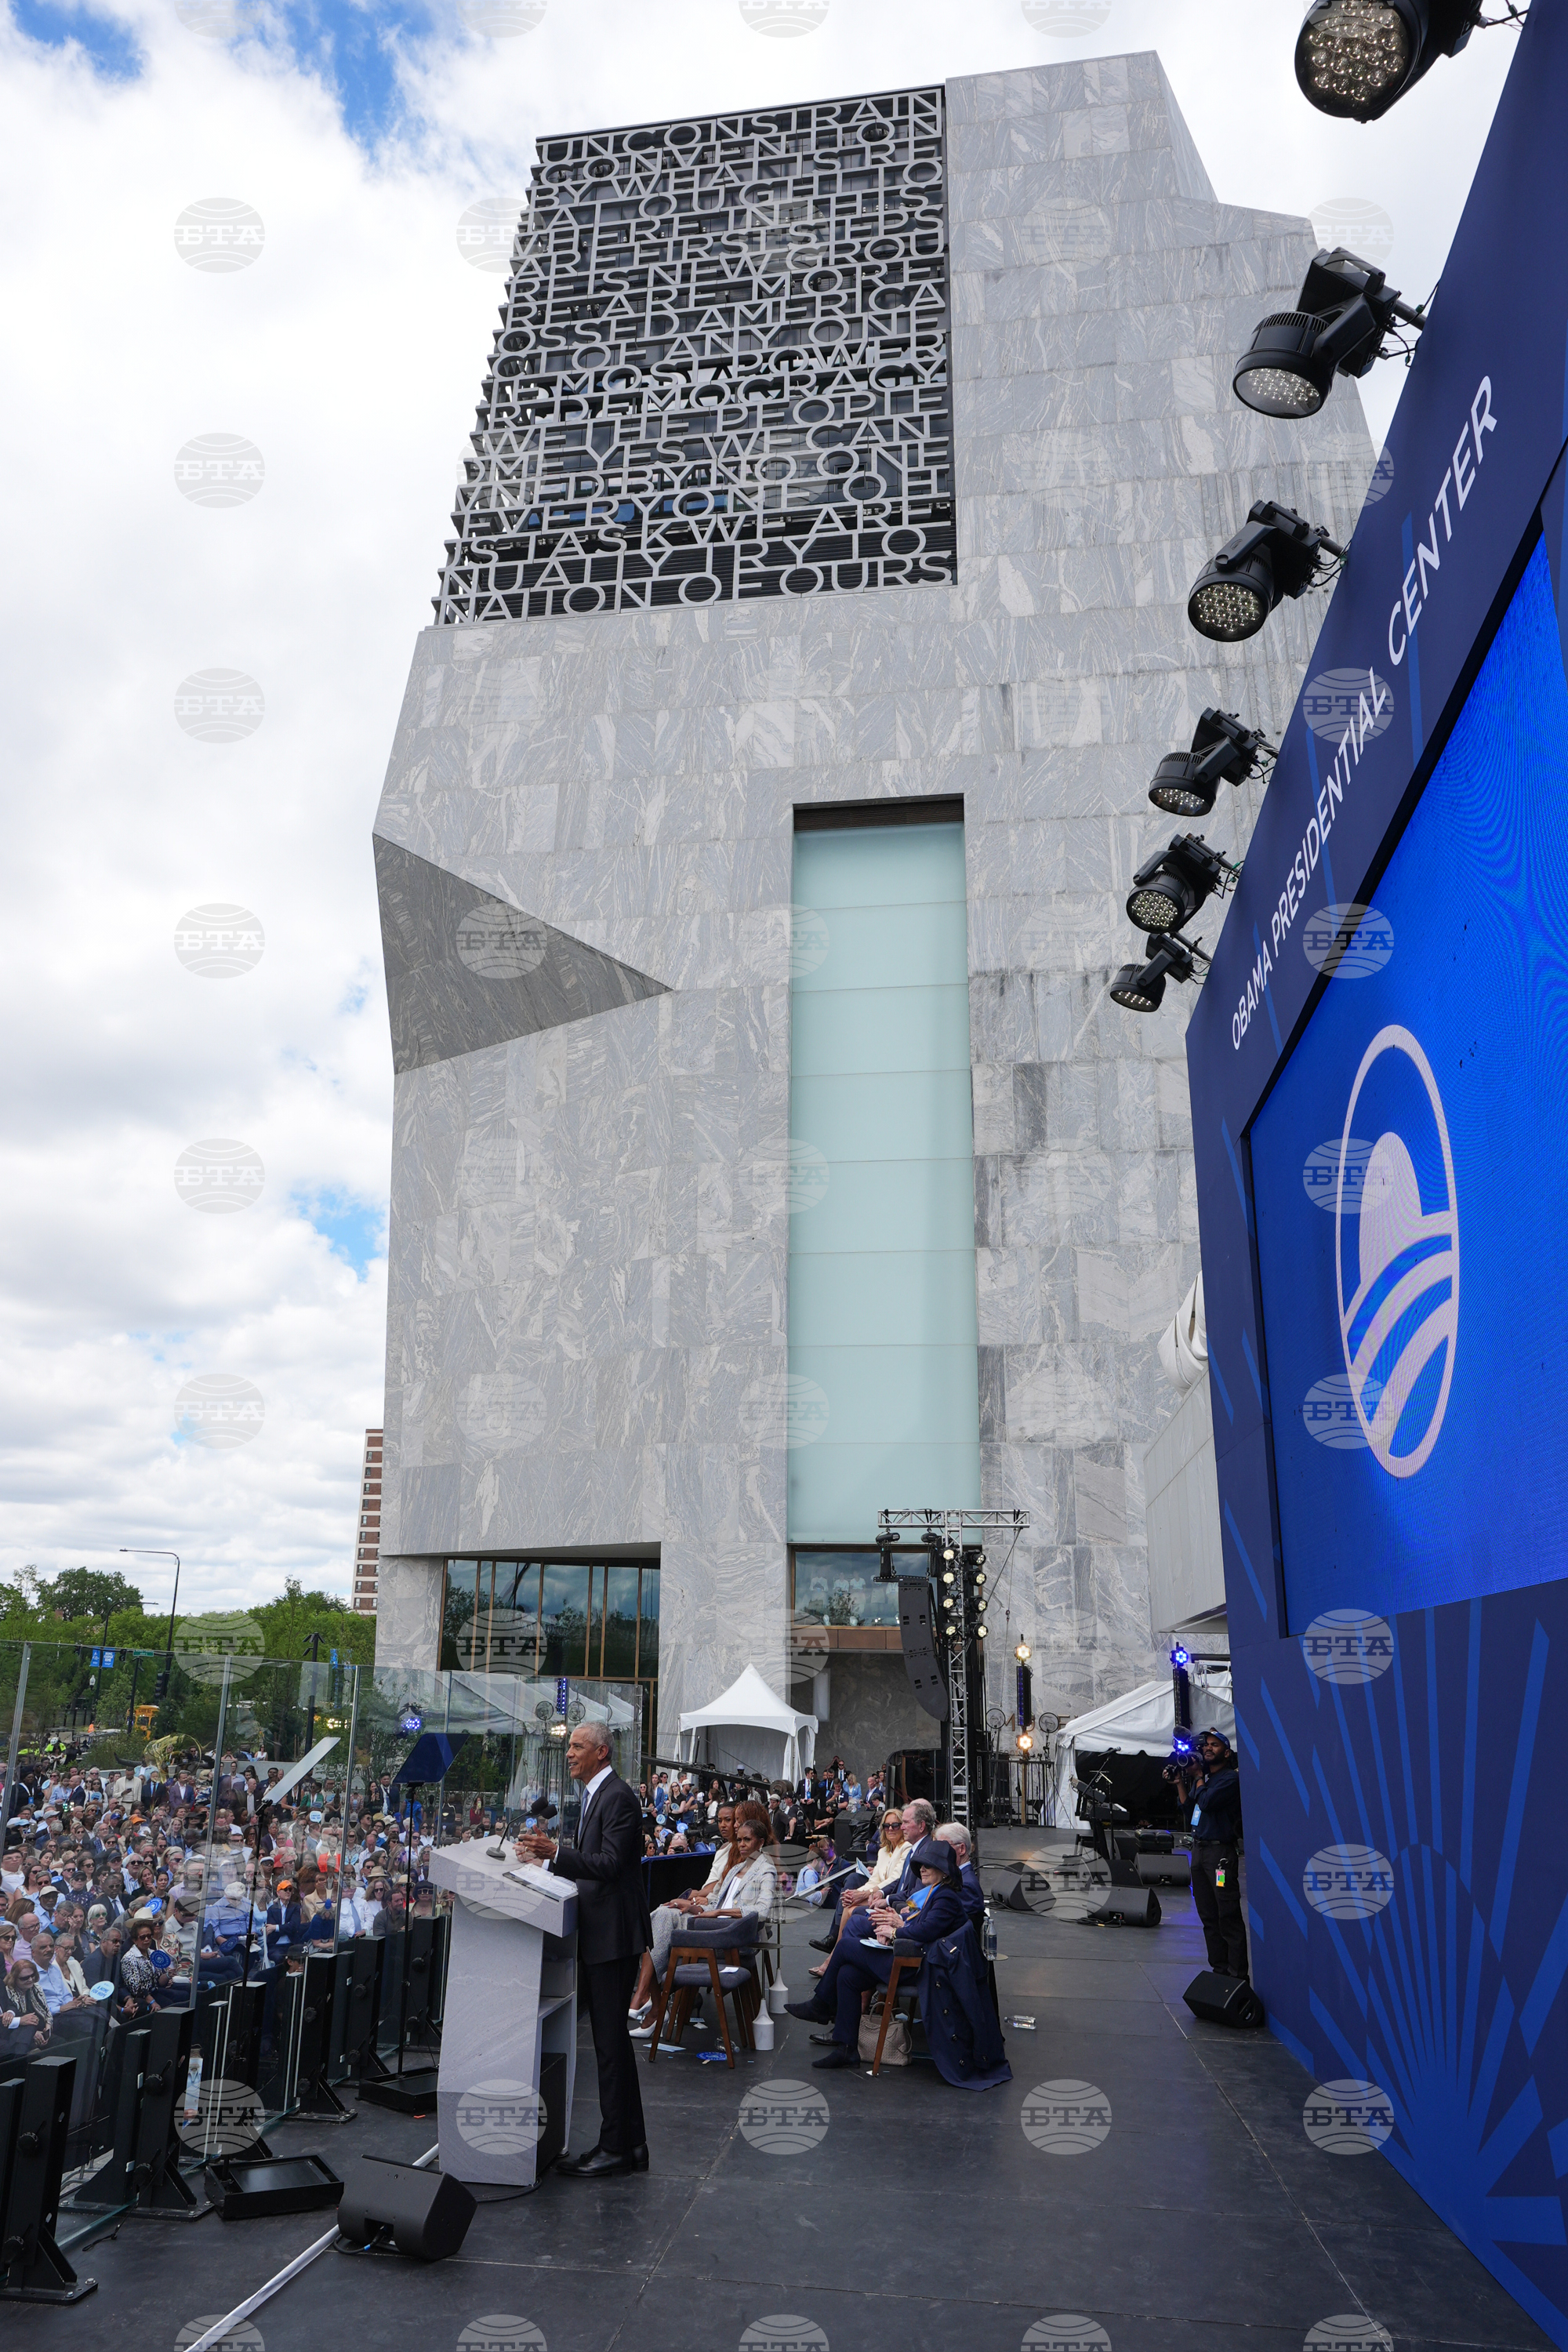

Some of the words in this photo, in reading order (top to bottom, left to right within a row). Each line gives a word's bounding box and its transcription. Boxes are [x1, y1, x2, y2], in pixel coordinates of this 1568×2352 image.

[1232, 940, 1272, 1050] OBAMA
[1271, 666, 1386, 957] PRESIDENTIAL
[1388, 376, 1497, 666] CENTER
